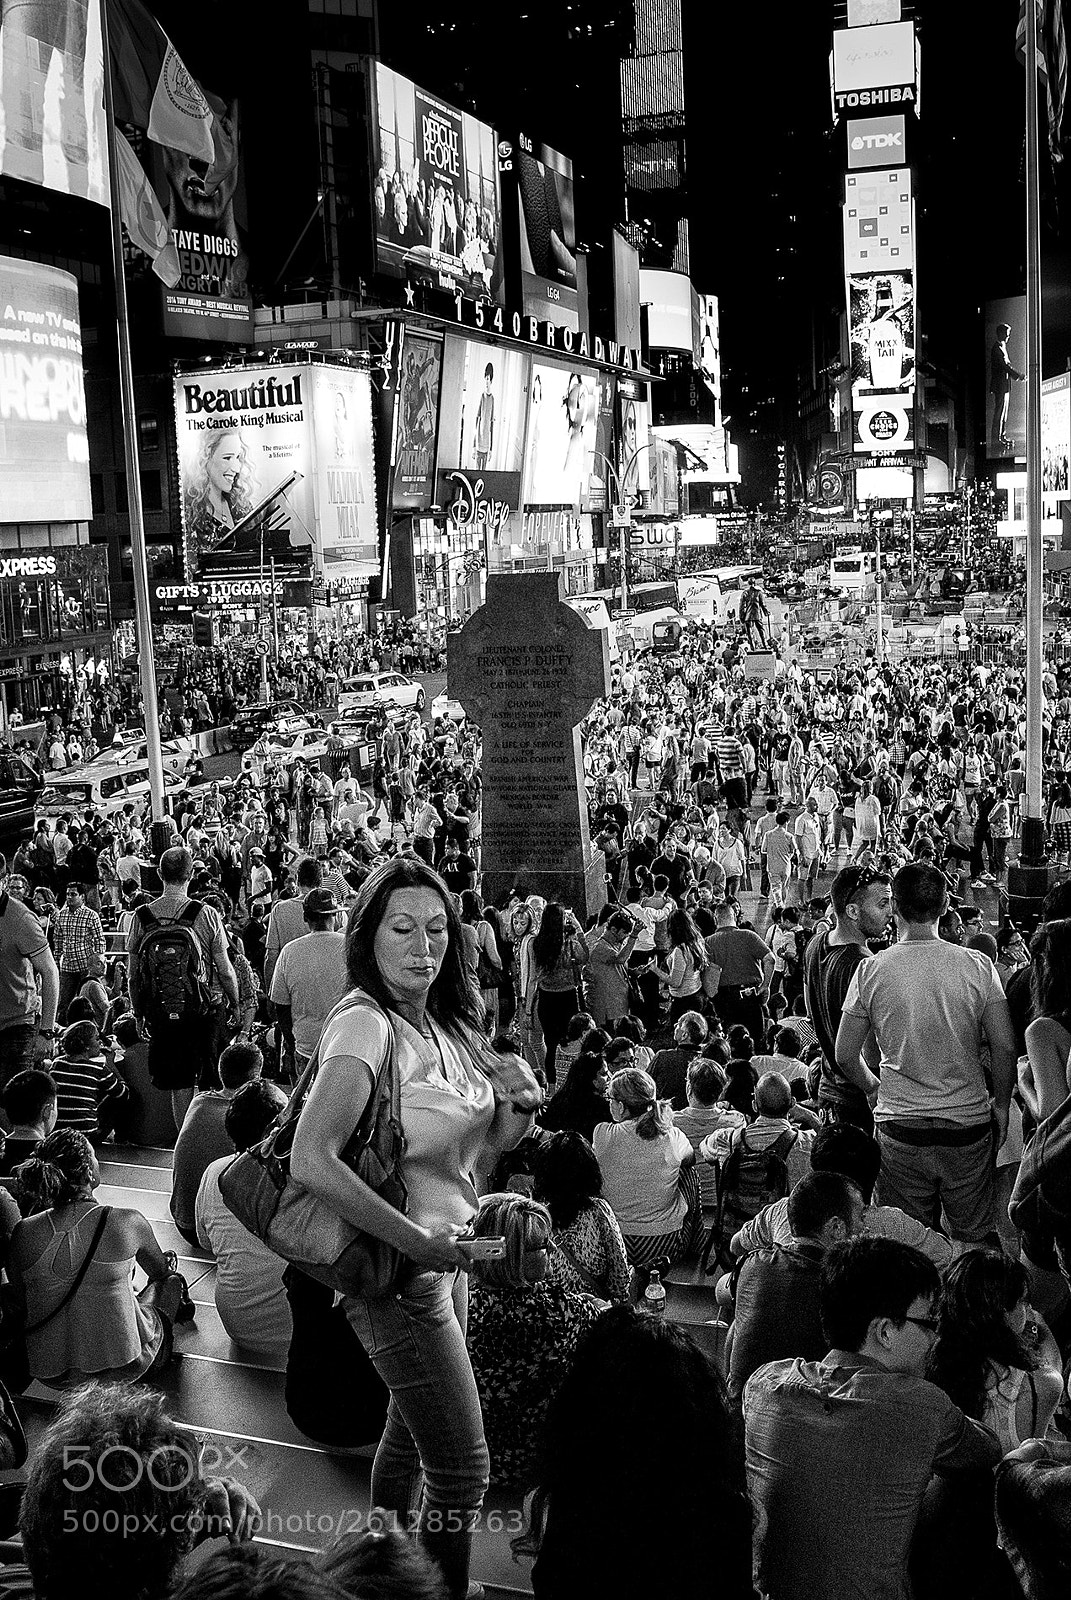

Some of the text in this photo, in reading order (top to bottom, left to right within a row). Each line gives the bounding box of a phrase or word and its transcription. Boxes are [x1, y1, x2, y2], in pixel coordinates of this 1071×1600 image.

[836, 87, 914, 108] TOSHIBA
[864, 131, 902, 149] TDK
[423, 136, 460, 178] PEOPLE
[499, 161, 513, 171] LG
[171, 228, 200, 251] TAYE
[203, 234, 239, 257] DIGGS
[4, 305, 16, 320] A
[17, 310, 45, 324] new
[45, 311, 62, 328] TV
[32, 332, 49, 345] on
[50, 333, 67, 350] the
[454, 295, 642, 370] 1540 BROADWAY
[874, 340, 898, 348] MIXX
[183, 374, 303, 414] Beautiful
[689, 376, 697, 407] 1500
[186, 409, 304, 431] The Carole King Musical
[0, 556, 56, 578] XPRESS
[156, 582, 284, 599] GIFTS LUGGAGE
[482, 645, 565, 654] LIEUTENANT COLONEL
[477, 655, 574, 667] FRANCIS P DUFFY
[532, 681, 562, 689] PRIEST
[507, 700, 545, 709] CHAPLAIN
[530, 756, 566, 764] COUNTRY
